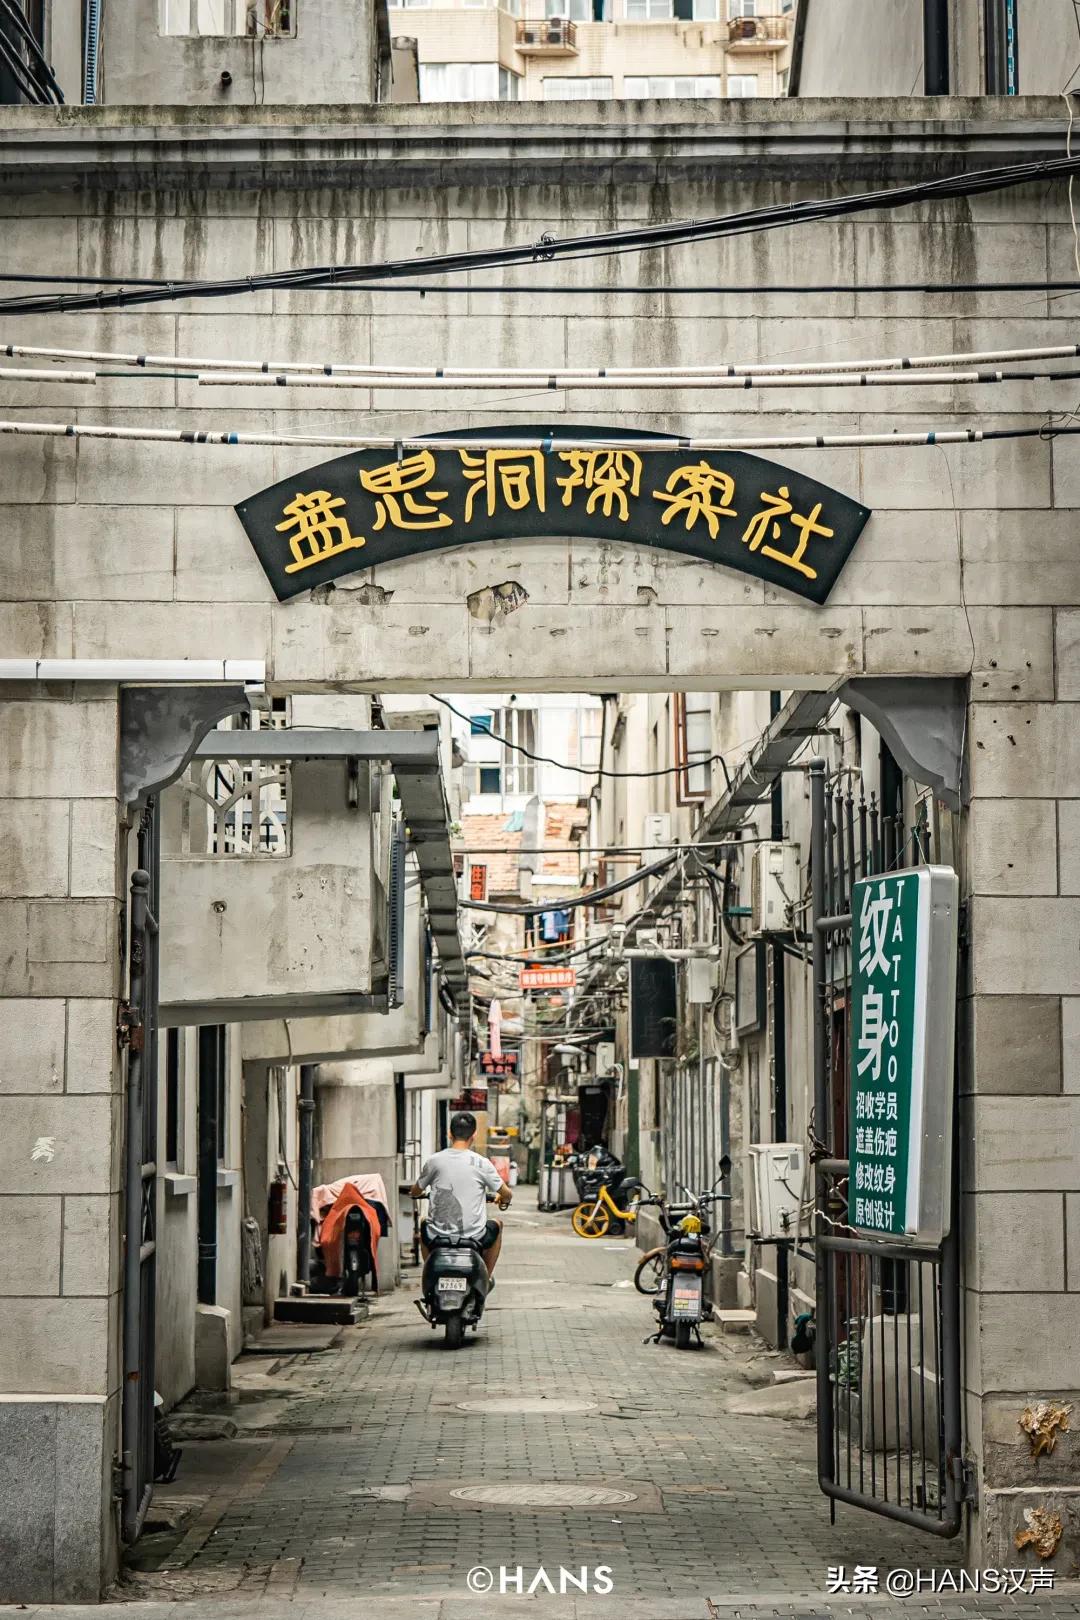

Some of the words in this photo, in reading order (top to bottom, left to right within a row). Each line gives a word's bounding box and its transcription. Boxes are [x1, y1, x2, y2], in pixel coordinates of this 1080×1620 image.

[857, 880, 894, 1081] 纹身
[887, 880, 905, 1083] TATTOO
[856, 1090, 898, 1121] 招收学员
[855, 1125, 898, 1157] 遮盖伤疤
[855, 1161, 896, 1195] 修改纹身
[855, 1197, 895, 1231] 原创设计
